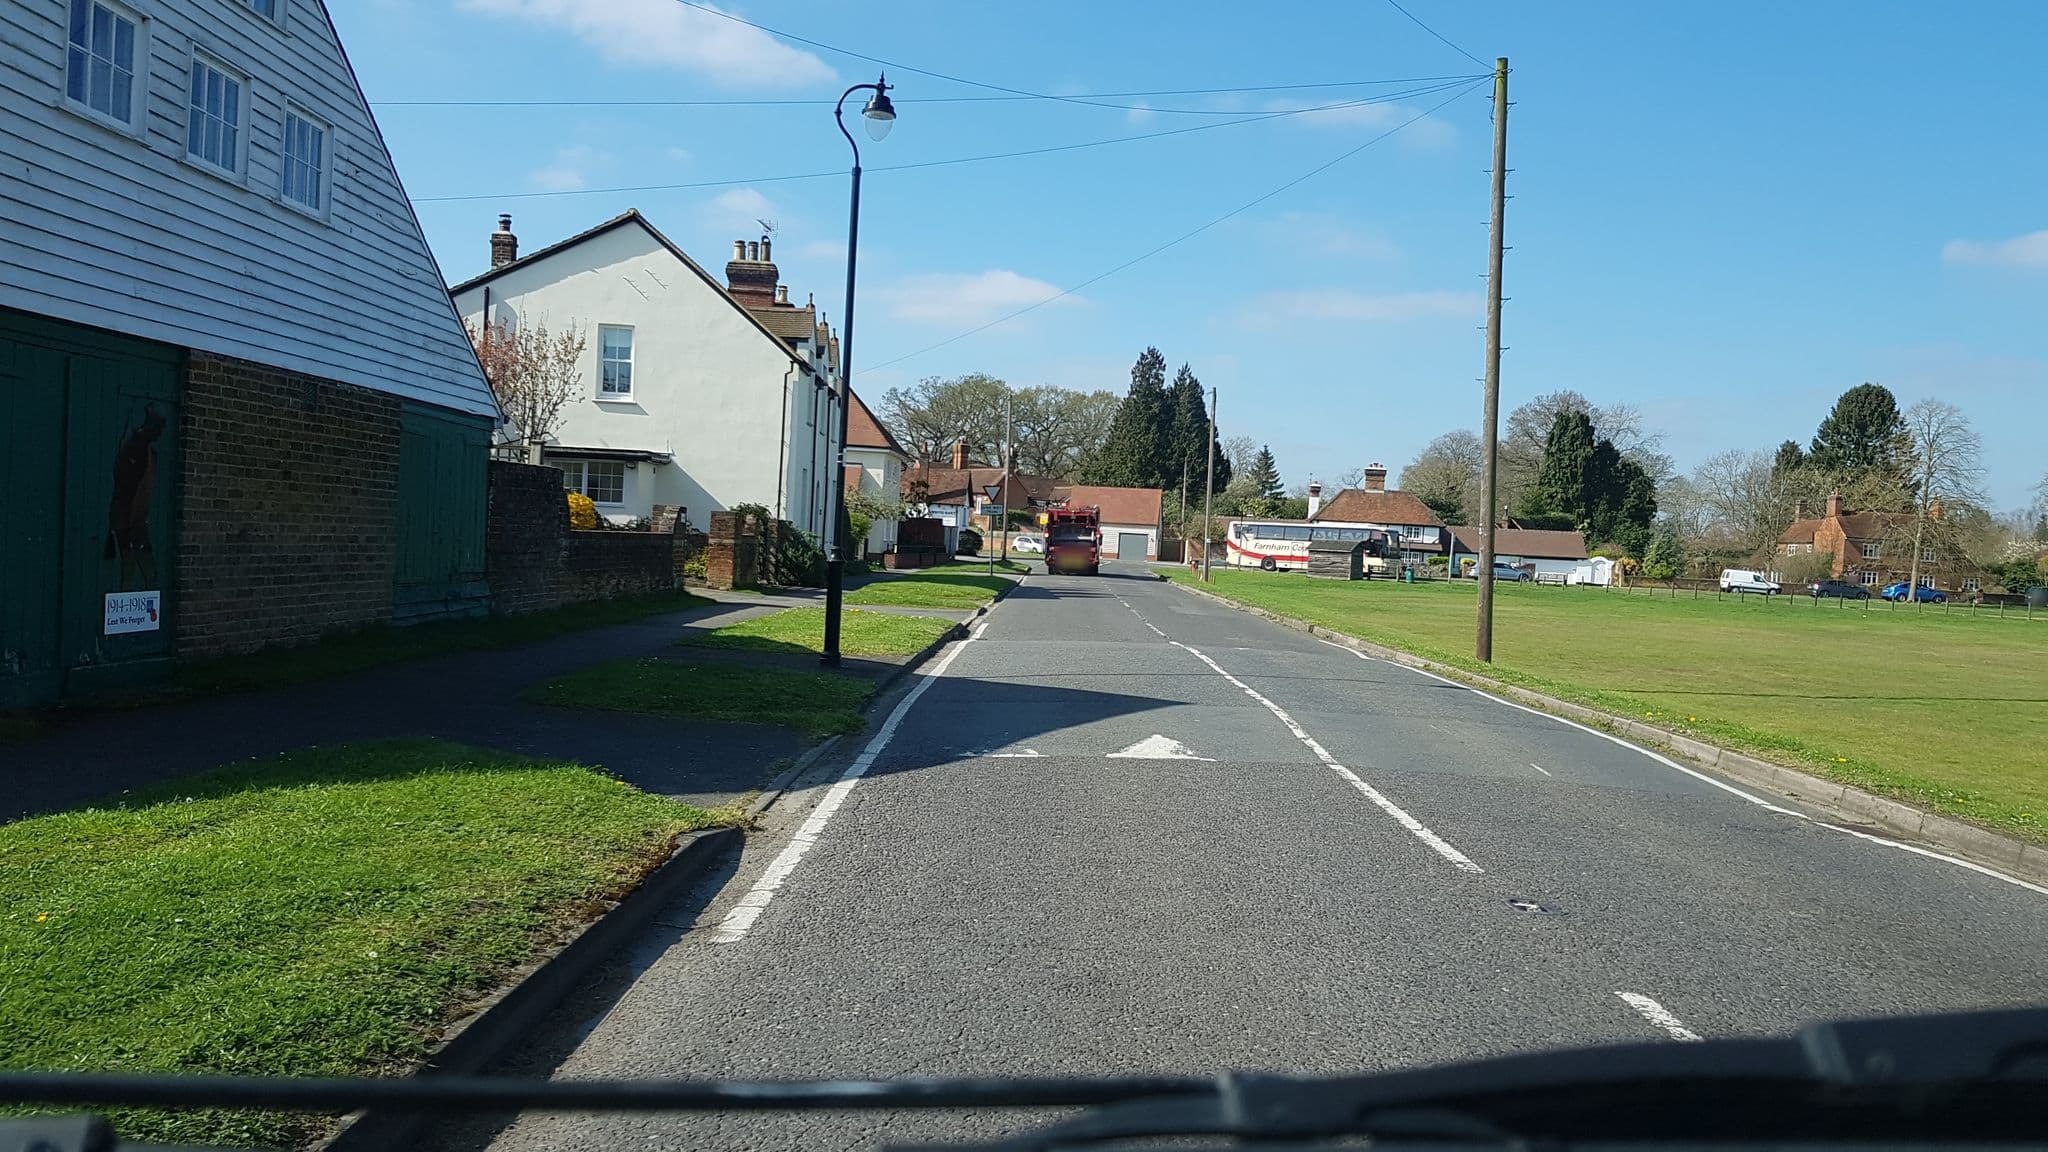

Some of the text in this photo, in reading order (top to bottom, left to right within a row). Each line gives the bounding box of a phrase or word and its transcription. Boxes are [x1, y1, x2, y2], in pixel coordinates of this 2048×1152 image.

[1254, 542, 1290, 552] Farnham
[107, 597, 147, 614] 1914-1918
[107, 615, 146, 626] Lest We Forget
